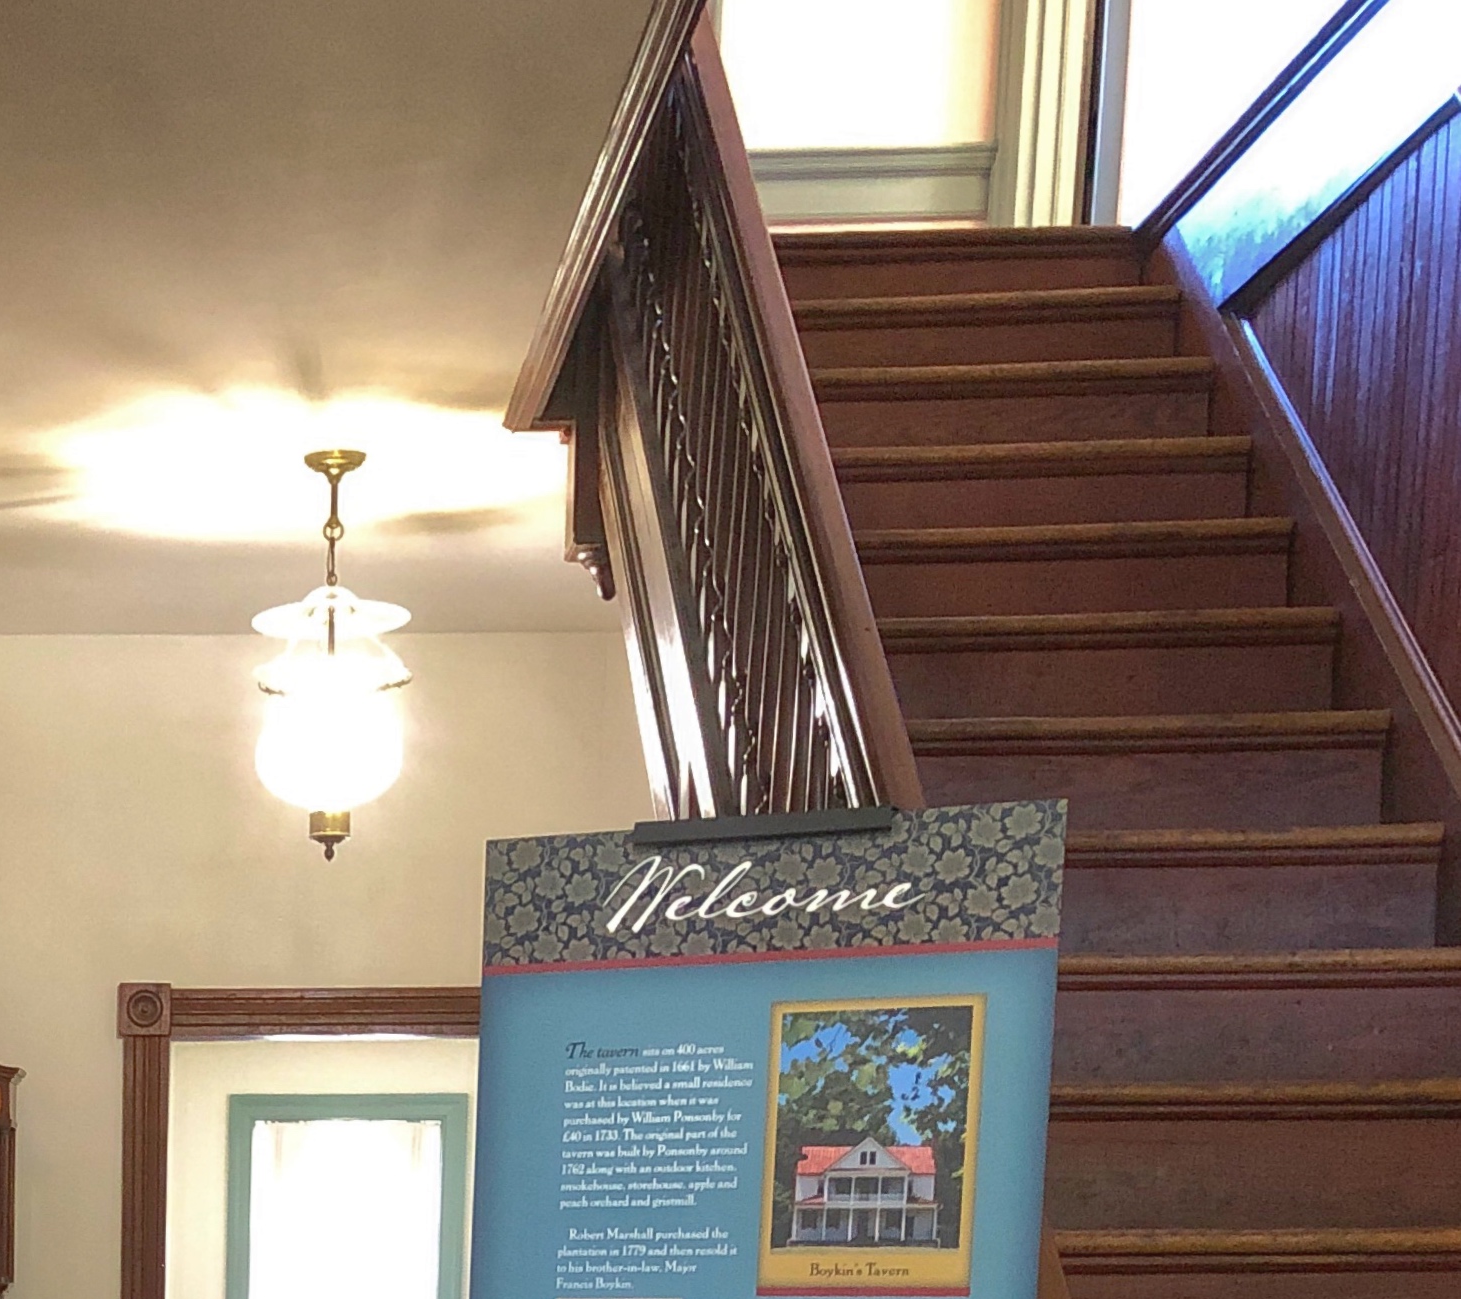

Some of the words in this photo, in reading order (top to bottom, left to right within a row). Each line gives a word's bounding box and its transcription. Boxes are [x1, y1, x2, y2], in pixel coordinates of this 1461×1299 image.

[603, 856, 926, 933] Welcome
[565, 1041, 594, 1059] The
[597, 1048, 638, 1058] tavern
[661, 1047, 675, 1055] on
[676, 1042, 696, 1055] 400
[564, 1062, 611, 1078] originally
[613, 1061, 658, 1077] patented
[659, 1061, 670, 1072] in
[672, 1059, 695, 1072] 1661
[697, 1059, 710, 1074] by
[712, 1057, 753, 1071] William
[598, 1079, 607, 1091] It
[619, 1077, 662, 1090] believed
[671, 1076, 701, 1089] small
[564, 1100, 584, 1108] was
[596, 1095, 616, 1107] this
[617, 1094, 657, 1107] location
[658, 1093, 687, 1106] when
[698, 1096, 719, 1105] was
[562, 1112, 615, 1128] purchased
[616, 1112, 629, 1126] by
[631, 1111, 671, 1123] William
[672, 1109, 725, 1125] Ponsonby
[726, 1109, 742, 1121] for
[562, 1129, 582, 1141] £40
[582, 1130, 592, 1141] in
[622, 1128, 643, 1140] The
[644, 1127, 684, 1142] original
[685, 1129, 706, 1141] part
[707, 1126, 719, 1138] of
[719, 1126, 737, 1138] the
[561, 1148, 594, 1158] tavern
[595, 1149, 615, 1157] was
[616, 1145, 640, 1157] built
[641, 1144, 655, 1159] by
[656, 1143, 708, 1159] Ponsonby
[710, 1143, 748, 1155] around
[561, 1162, 585, 1174] 1762
[585, 1162, 614, 1176] along
[614, 1161, 637, 1173] with
[653, 1160, 694, 1172] outdoor
[716, 1176, 738, 1188] and
[559, 1195, 589, 1210] peach
[589, 1195, 630, 1207] orchard
[630, 1195, 651, 1206] and
[569, 1228, 604, 1239] Robert
[606, 1227, 654, 1239] Marshall
[655, 1227, 710, 1242] purchased
[711, 1227, 728, 1238] the
[557, 1244, 607, 1258] plantation
[609, 1245, 619, 1256] in
[622, 1244, 646, 1256] 1779
[647, 1244, 668, 1255] and
[669, 1244, 693, 1255] then
[694, 1244, 728, 1255] resold
[556, 1263, 567, 1272] to
[567, 1260, 583, 1272] his
[664, 1260, 697, 1275] Major
[809, 1262, 863, 1278] Boykin's
[865, 1261, 909, 1276] Tavern
[555, 1277, 593, 1288] Francis
